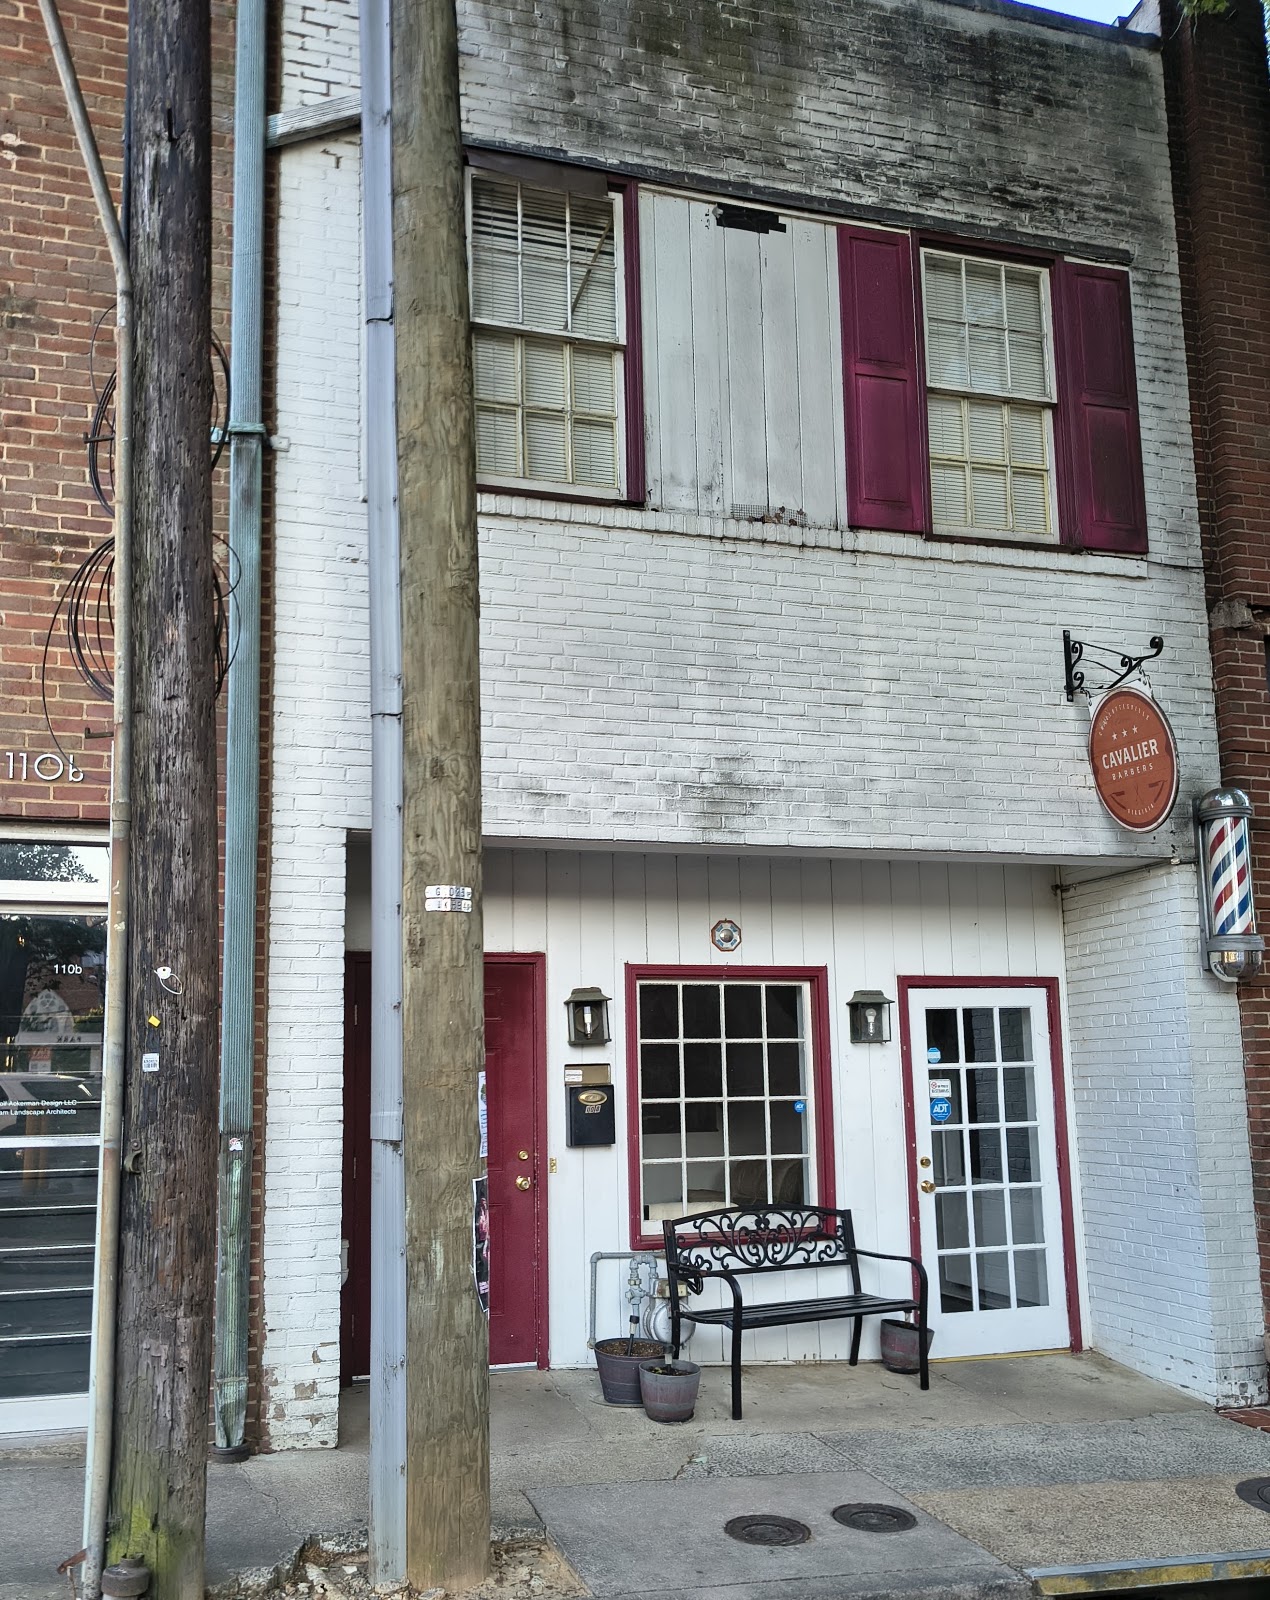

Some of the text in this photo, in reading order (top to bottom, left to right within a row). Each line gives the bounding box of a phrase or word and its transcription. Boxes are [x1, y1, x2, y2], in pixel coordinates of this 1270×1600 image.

[1102, 739, 1159, 769] CAVALIER
[5, 751, 84, 782] 110b
[1112, 763, 1153, 780] BARBERS
[53, 964, 83, 975] 110b
[41, 1099, 63, 1107] Design
[933, 1103, 949, 1113] ADT
[10, 1109, 45, 1117] Landscape
